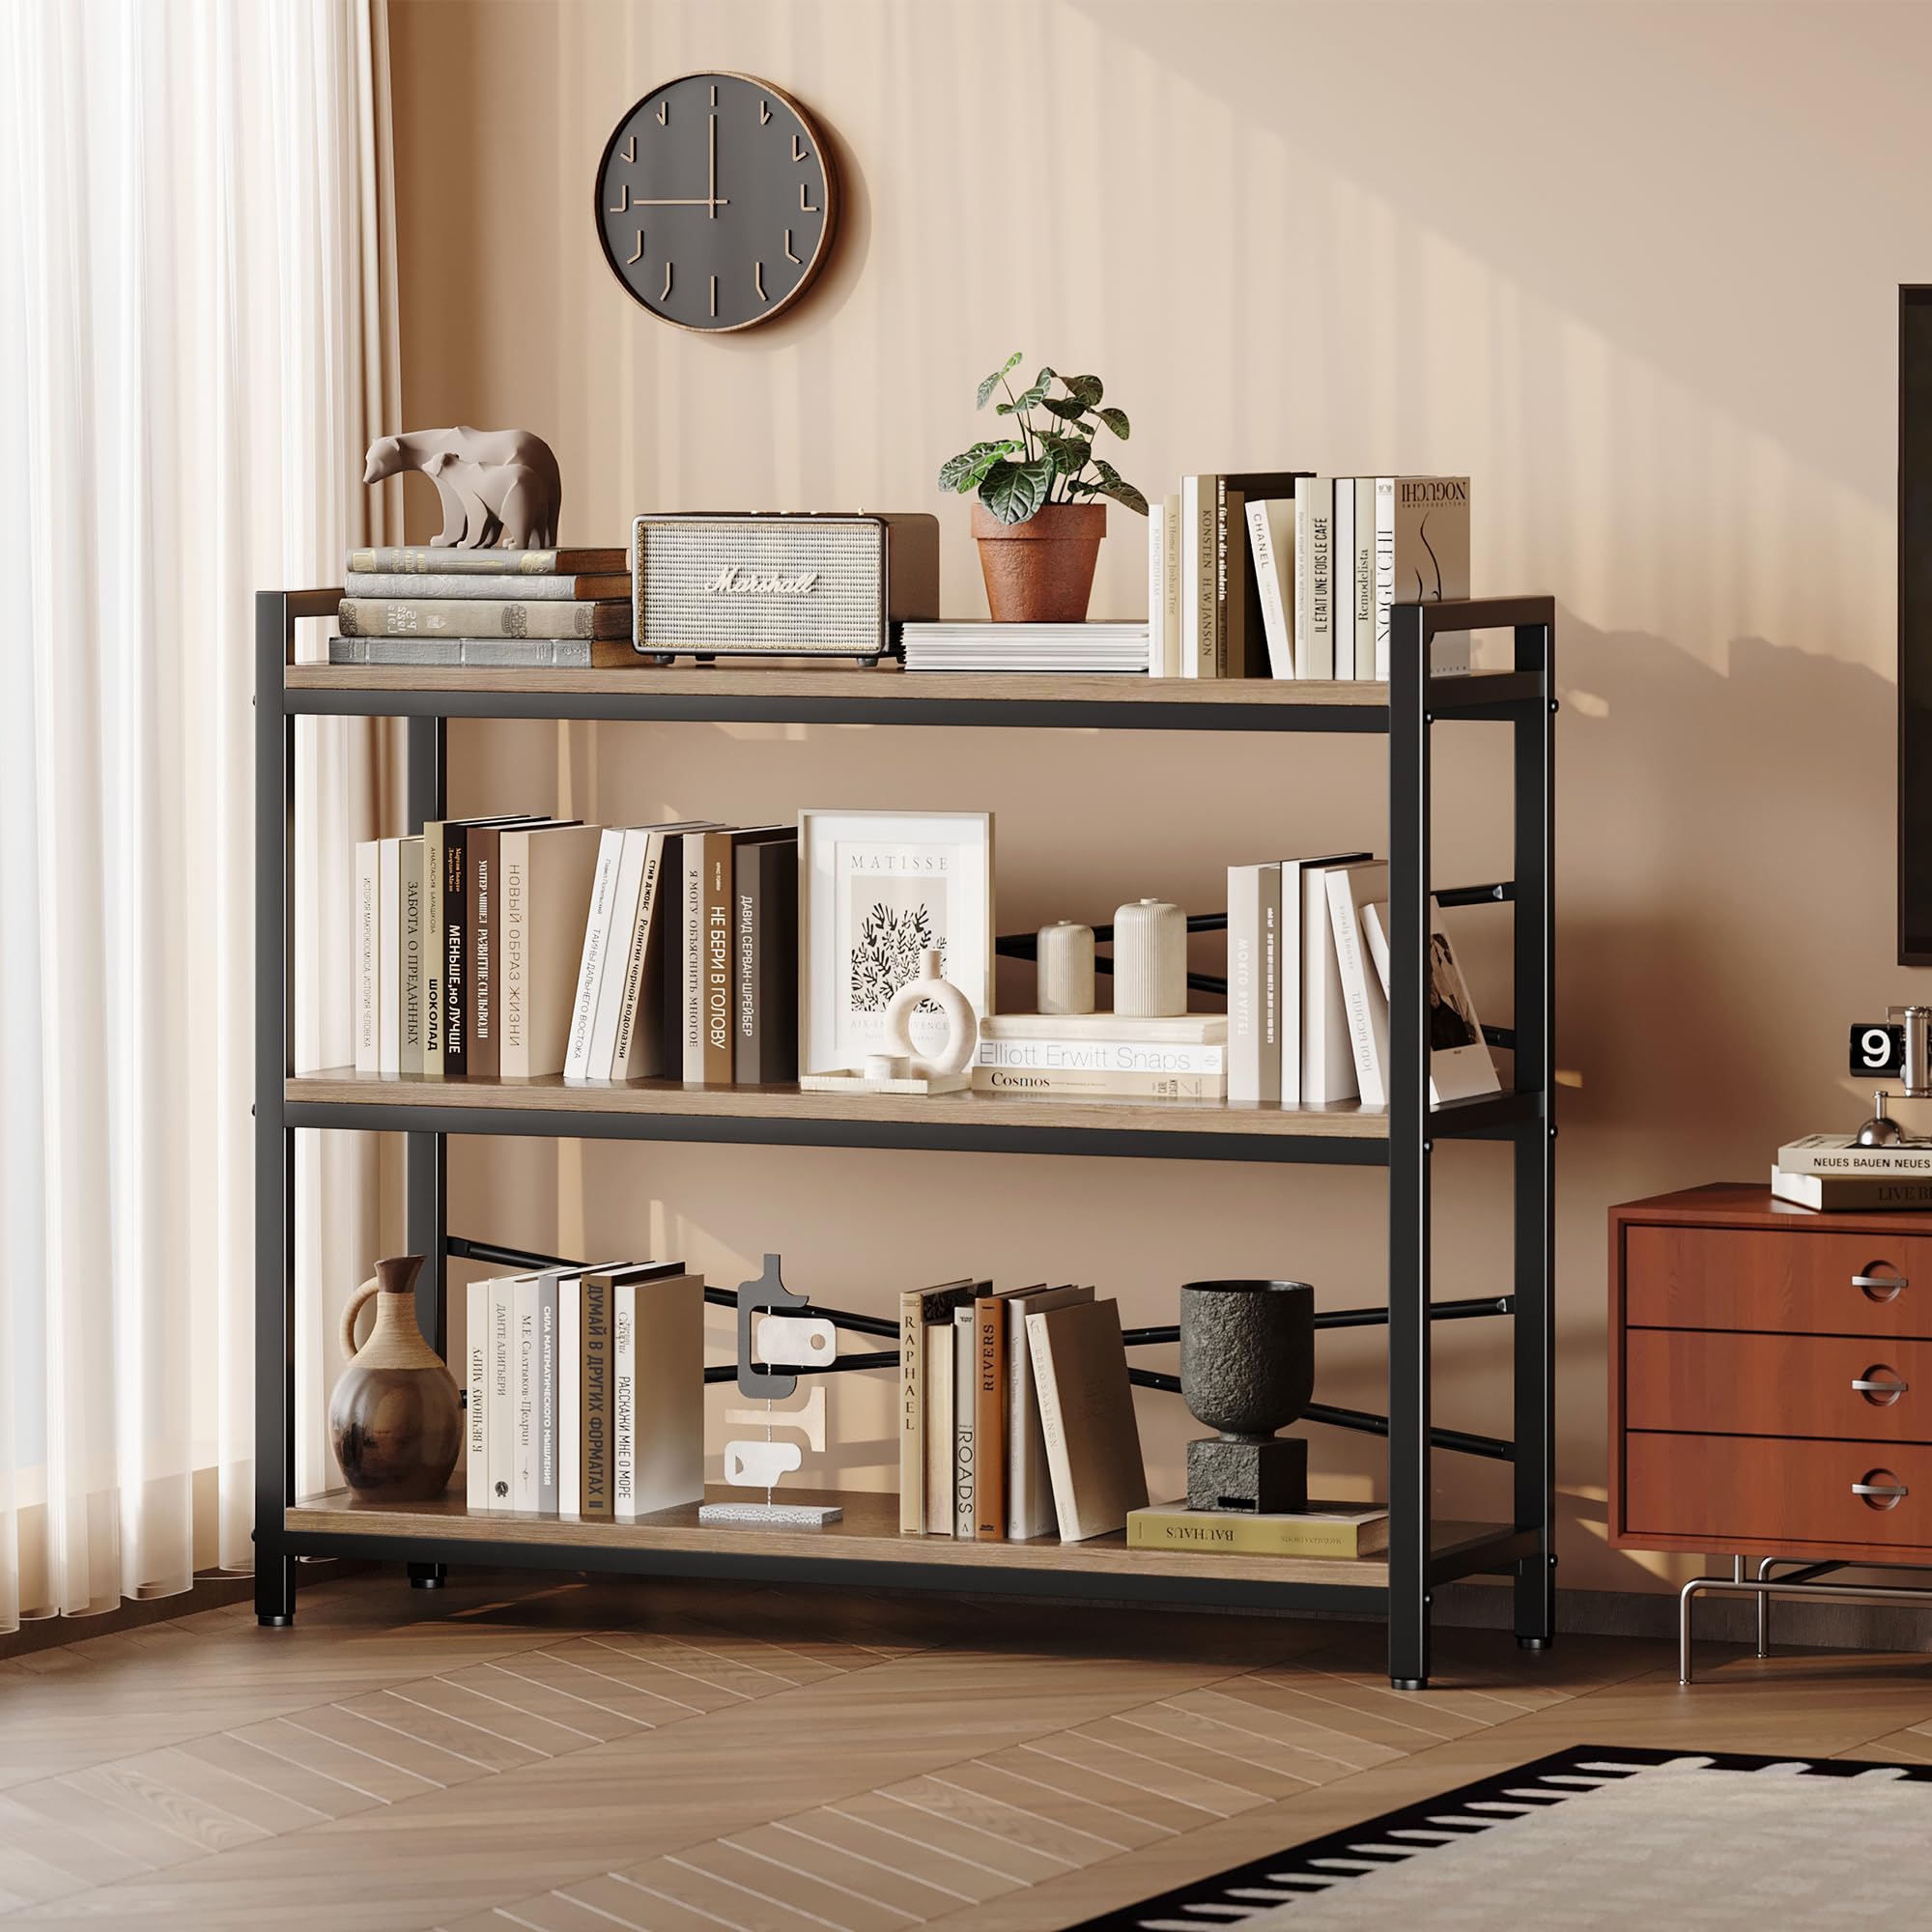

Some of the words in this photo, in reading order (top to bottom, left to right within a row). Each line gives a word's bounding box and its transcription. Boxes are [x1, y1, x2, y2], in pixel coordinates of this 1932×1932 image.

[1401, 482, 1466, 502] NOGUCHI
[1203, 510, 1212, 569] KONSTEN
[1253, 513, 1267, 570] CHANEL
[1312, 517, 1327, 541] CAFÉ
[1315, 543, 1327, 554] LE
[705, 565, 819, 592] Marshall
[1315, 555, 1327, 575] FOIS
[1357, 549, 1369, 621] Remodelista
[1378, 530, 1393, 641] NOGUCHI
[1315, 578, 1327, 595] UNE
[1312, 598, 1327, 622] ÉTAIT
[1315, 624, 1327, 633] IL
[646, 860, 656, 880] СТИВ
[850, 855, 949, 870] MATISSE
[408, 881, 418, 935] ЗАБОТА
[509, 865, 523, 923] НОВЫЙ
[641, 882, 652, 911] ДЖОБС
[690, 882, 698, 915] МОГУ
[740, 895, 753, 933] ДАВИД
[710, 906, 725, 926] НЕ
[408, 940, 418, 951] О
[509, 929, 521, 980] ОБРАЗ
[634, 919, 648, 961] Религия
[690, 920, 698, 993] ОБЪЯСНИТЬ
[710, 930, 725, 970] БЕРИ
[581, 962, 596, 1013] ДАЛЬНЕГО
[710, 974, 725, 983] В
[742, 935, 754, 1037] СЕРВАН-ШРЕЙБЕР
[407, 954, 418, 1046] ПРЕДАННЫХ
[427, 979, 438, 1051] ШОКОЛАД
[509, 986, 521, 1047] ЖИЗНИ
[710, 987, 725, 1049] ГОЛОВУ
[447, 1007, 461, 1054] ЛУЧШЕ
[573, 1013, 587, 1059] ВОСТОКА
[618, 1002, 634, 1059] водолазки
[690, 997, 698, 1048] МНОГОЕ
[980, 1043, 1037, 1065] Elliott
[1046, 1045, 1108, 1068] Erwitt
[1117, 1046, 1190, 1073] Snaps
[1861, 1029, 1891, 1067] 9
[991, 1071, 1050, 1088] Cosmos
[1813, 1157, 1849, 1168] NEUES
[1853, 1158, 1890, 1168] BAUEN
[1894, 1158, 1931, 1169] NEUES
[1878, 1186, 1915, 1201] LIVE
[496, 1303, 506, 1339] ДАНТЕ
[587, 1283, 608, 1336] ДУМАЙ
[472, 1347, 483, 1382] МИРУ
[588, 1341, 604, 1350] В
[982, 1323, 995, 1392] RIVERS
[497, 1341, 506, 1397] АЛИГЬЕРИ
[587, 1355, 604, 1412] ДРУГИХ
[904, 1316, 916, 1431] RAPHAEL
[472, 1387, 483, 1441] ВЕЧНОМУ
[618, 1376, 631, 1432] РАССКАЖИ
[588, 1417, 604, 1495] ФОРМАТАХ
[618, 1435, 631, 1458] МНЕ
[618, 1470, 631, 1498] МОРЕ
[958, 1431, 973, 1515] ROADS
[1166, 1527, 1235, 1542] BAUHAUS
